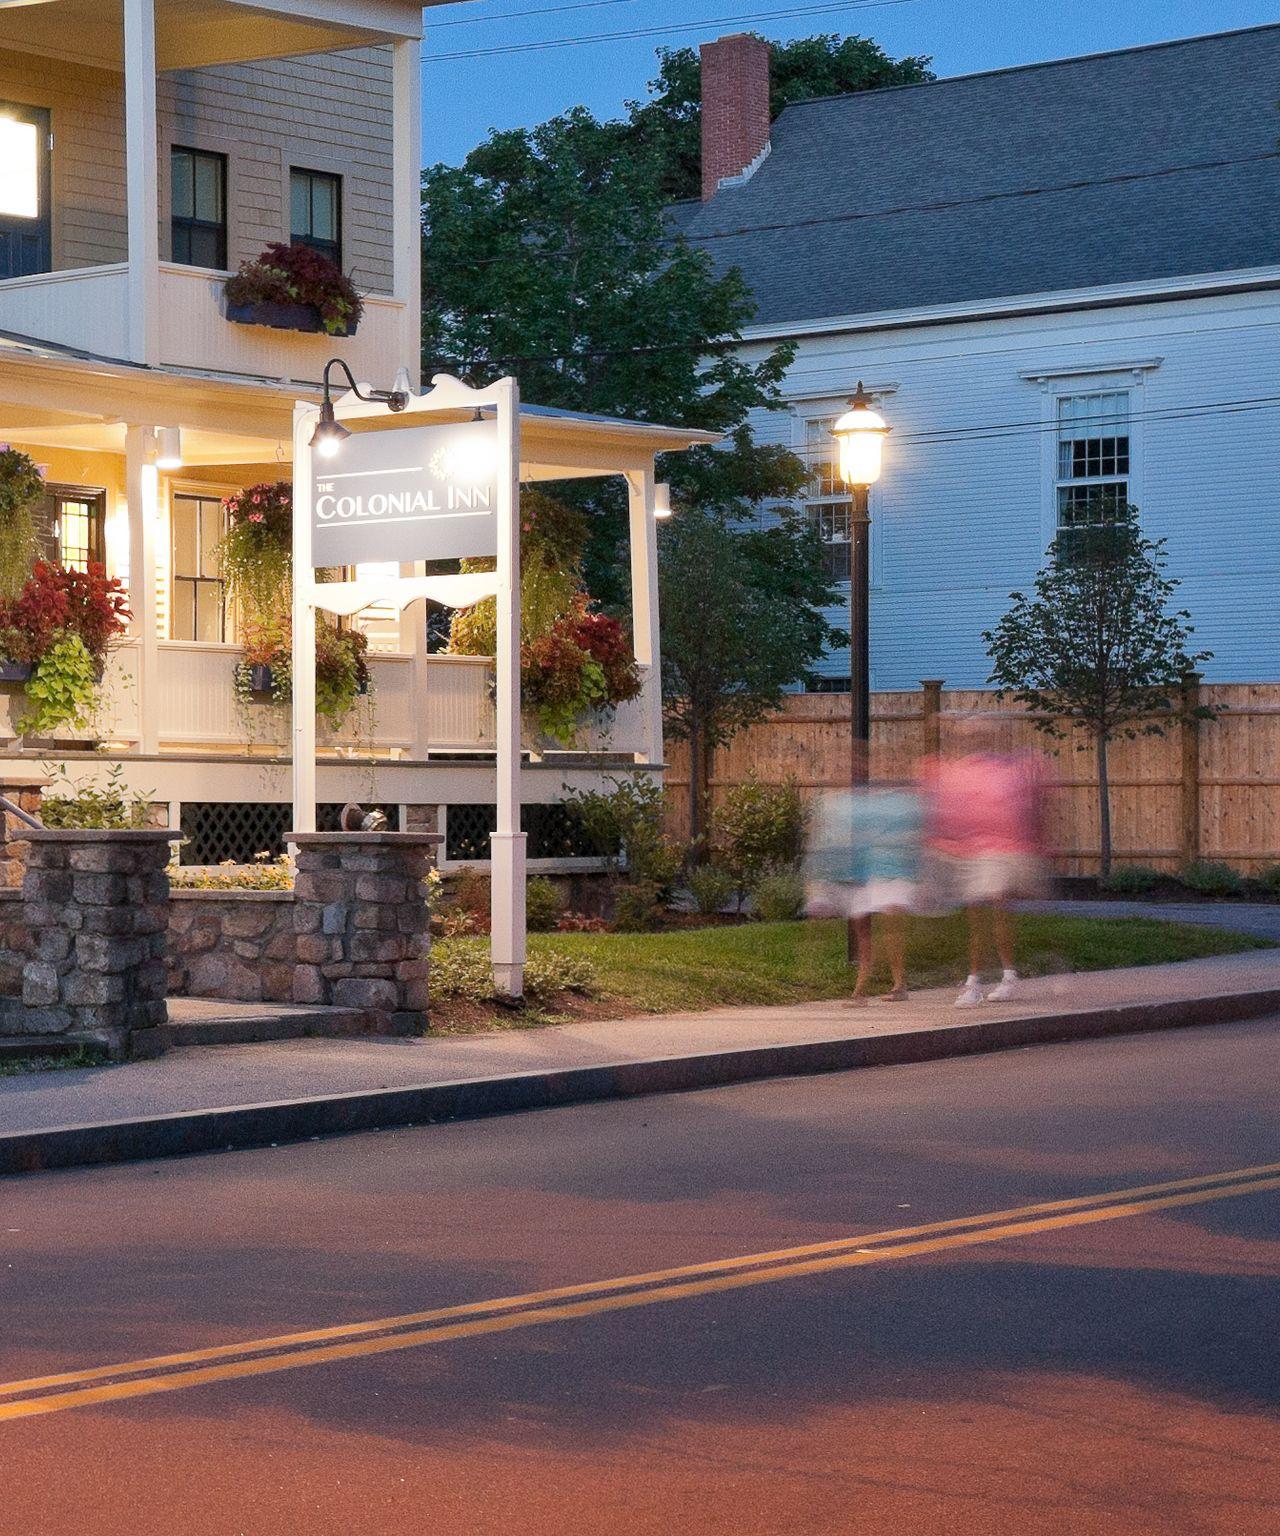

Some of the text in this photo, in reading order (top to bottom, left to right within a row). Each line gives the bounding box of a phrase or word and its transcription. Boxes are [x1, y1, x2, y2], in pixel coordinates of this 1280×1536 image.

[316, 482, 335, 493] THE
[316, 485, 491, 520] COLONIAL INN
